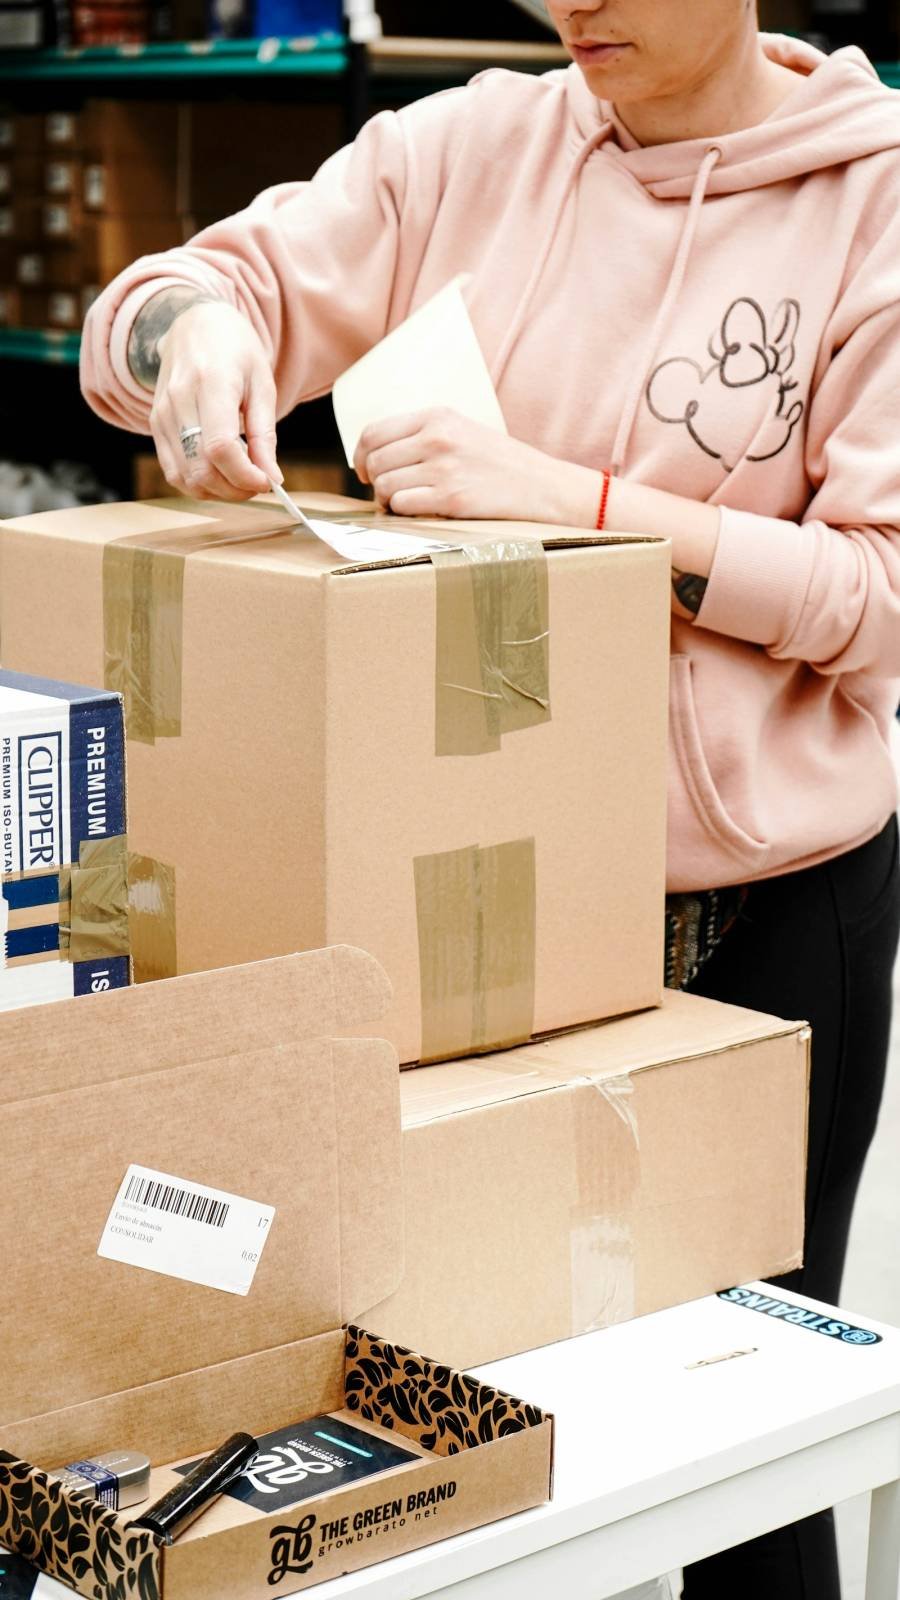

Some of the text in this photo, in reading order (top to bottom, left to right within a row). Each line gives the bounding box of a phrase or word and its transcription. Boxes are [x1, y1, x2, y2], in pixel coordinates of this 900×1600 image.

[2, 738, 11, 800] PREMIUM
[87, 726, 106, 836] PREMIUM
[27, 746, 54, 866] CLIPPER
[258, 1217, 269, 1229] 17
[720, 1288, 850, 1336] STRAINS
[318, 1518, 406, 1557] growbarato
[319, 1481, 457, 1543] THE GREEN BRAND
